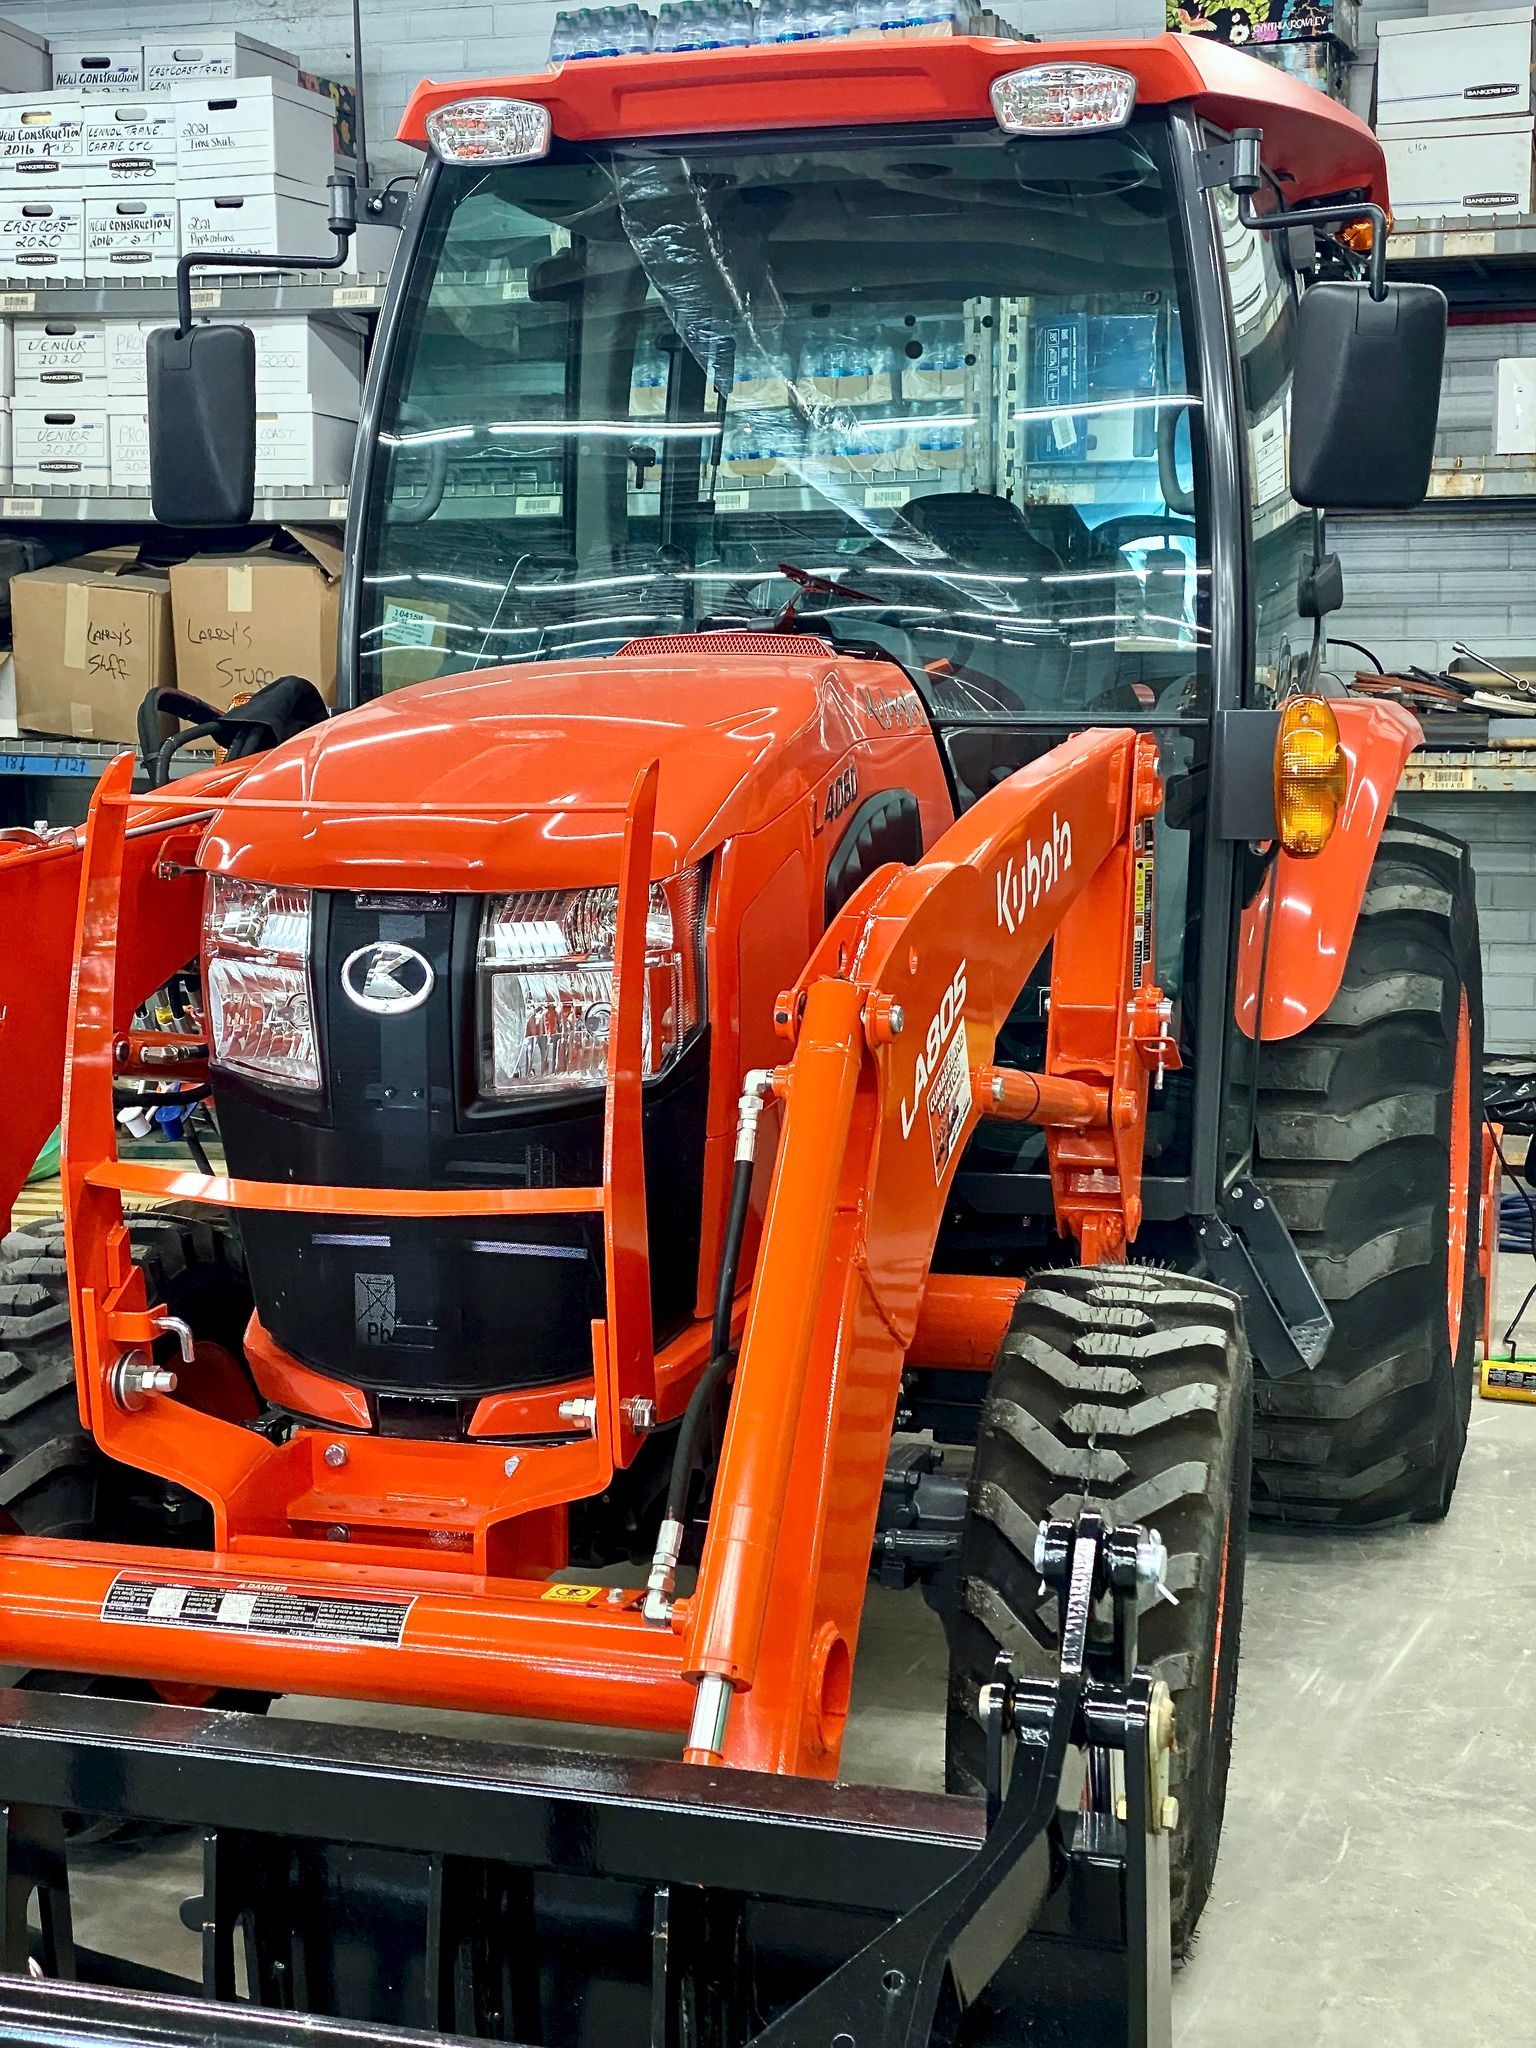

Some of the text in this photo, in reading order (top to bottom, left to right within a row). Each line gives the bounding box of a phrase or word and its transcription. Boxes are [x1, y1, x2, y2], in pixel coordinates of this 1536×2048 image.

[1252, 15, 1326, 34] CYNTHIA ROWLEY
[170, 66, 198, 75] COAST
[56, 73, 77, 85] NEW
[1466, 88, 1500, 97] BANKERS
[18, 121, 84, 142] CONSTRUCTION
[124, 124, 160, 136] TRANE
[183, 122, 209, 136] 2021
[3, 220, 78, 234] EAST COAST
[109, 217, 172, 231] CONSTRUCTION
[15, 234, 62, 248] 2020
[38, 353, 83, 365] 2020
[37, 428, 90, 443] VENDOR
[41, 443, 87, 456] 2020
[996, 811, 1072, 935] Kubota
[901, 957, 967, 1140] LA805
[247, 1583, 288, 1592] DANGER
